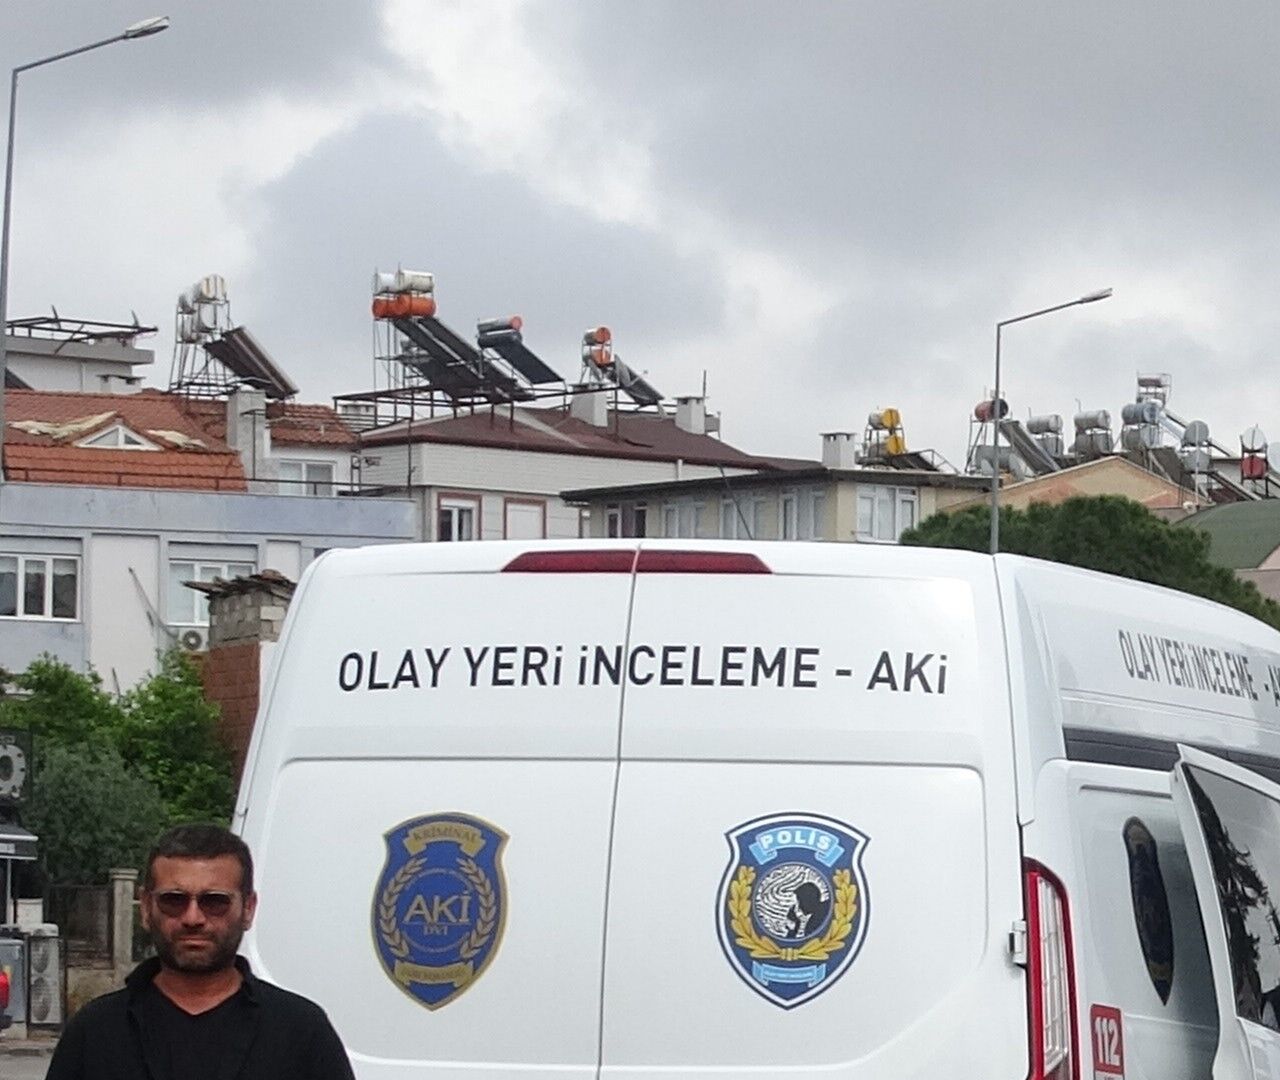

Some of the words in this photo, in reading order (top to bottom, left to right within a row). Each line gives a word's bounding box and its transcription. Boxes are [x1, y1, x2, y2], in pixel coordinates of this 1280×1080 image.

[338, 647, 451, 691] OLAY
[1118, 629, 1161, 682] OLAY
[759, 830, 833, 851] POLİS
[403, 889, 473, 924] AKİ
[1093, 1016, 1120, 1068] 112
